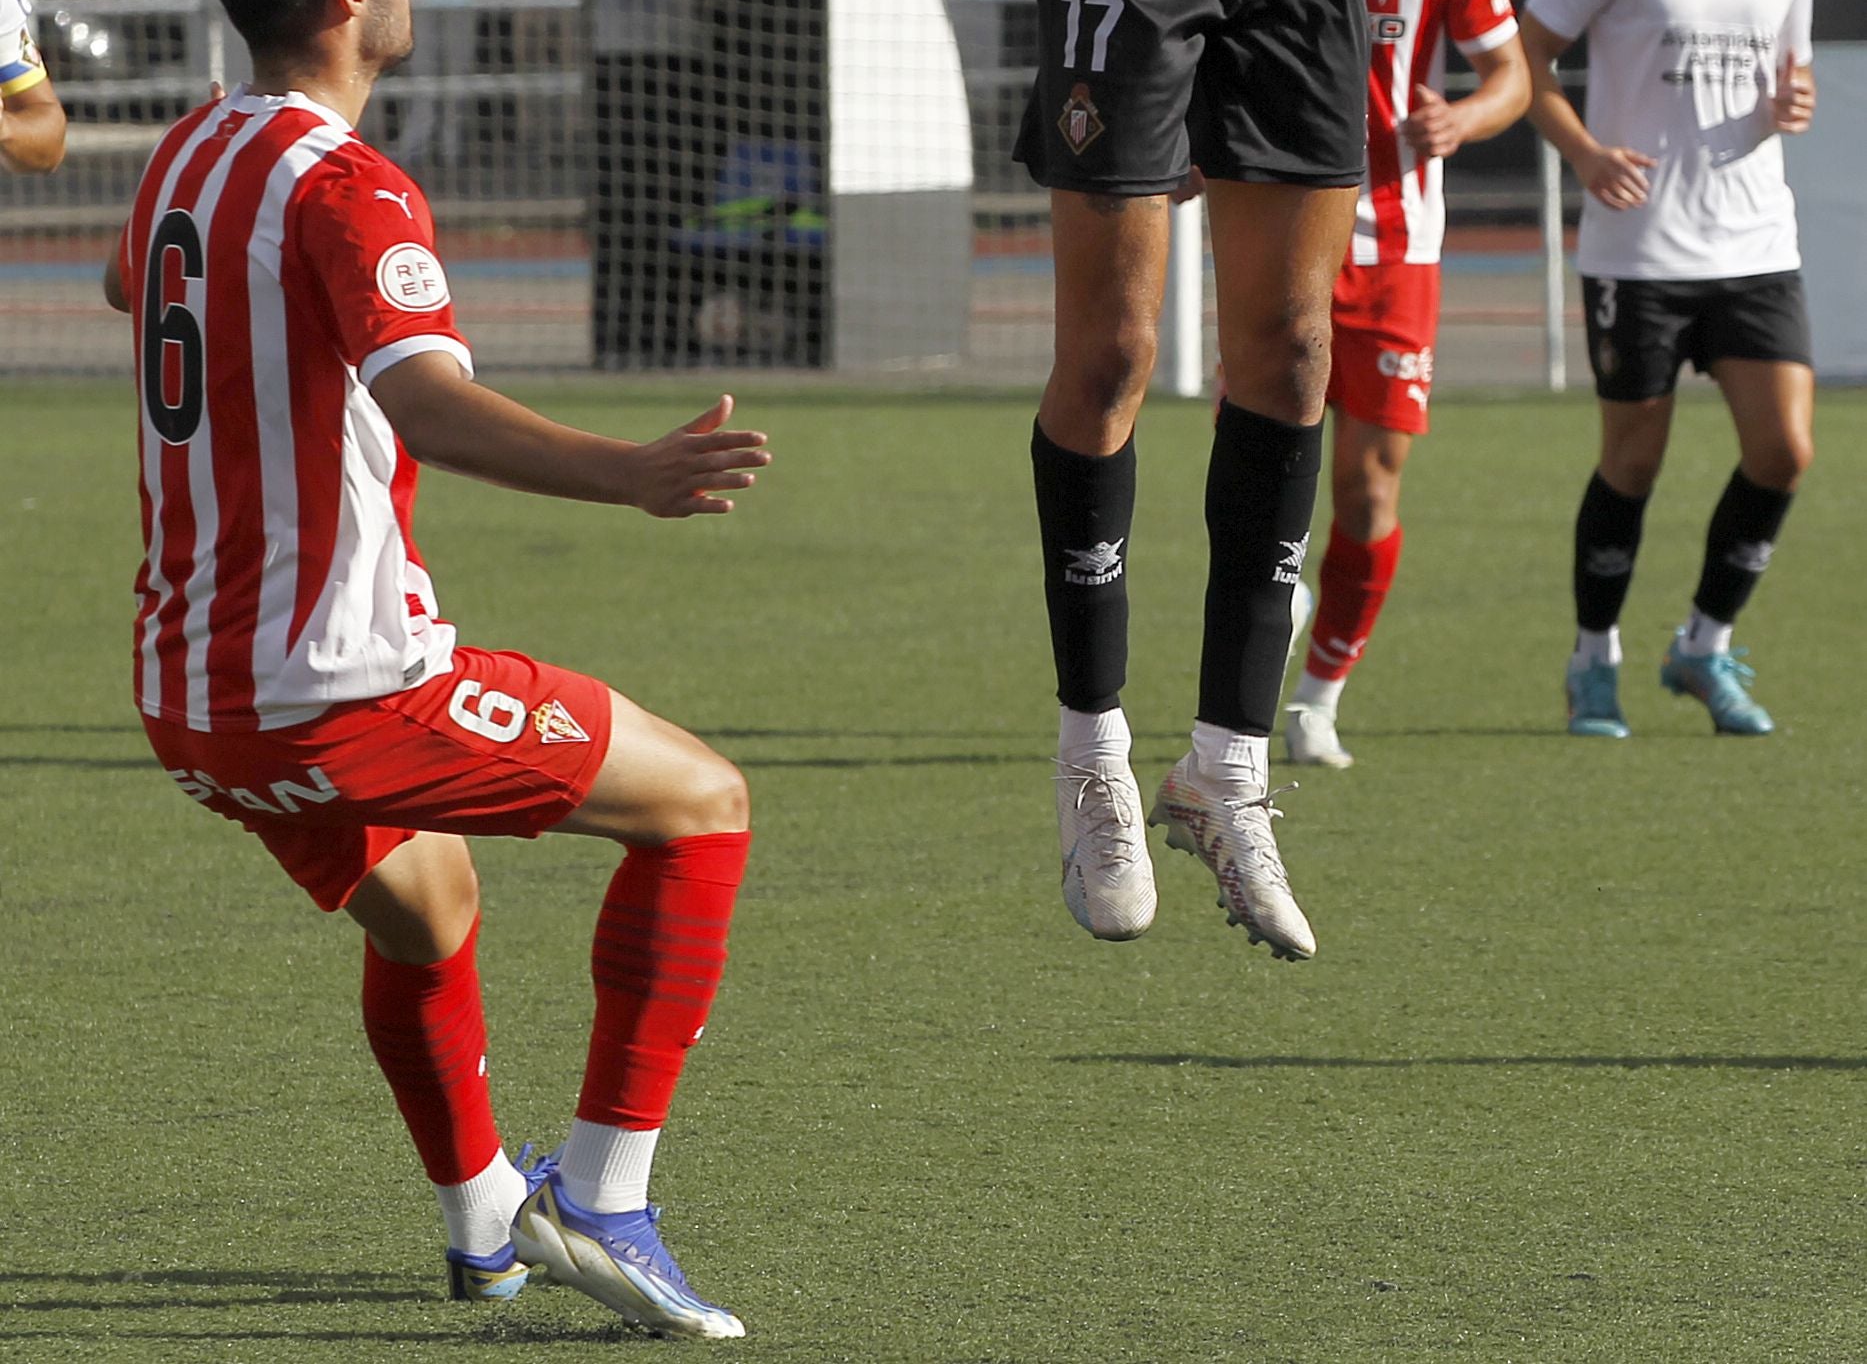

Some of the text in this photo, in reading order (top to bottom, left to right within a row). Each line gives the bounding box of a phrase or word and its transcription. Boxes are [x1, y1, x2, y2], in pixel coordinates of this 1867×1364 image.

[144, 208, 206, 447] 6
[1596, 278, 1618, 328] 3
[1064, 561, 1123, 585] luanvi
[448, 679, 527, 743] 6
